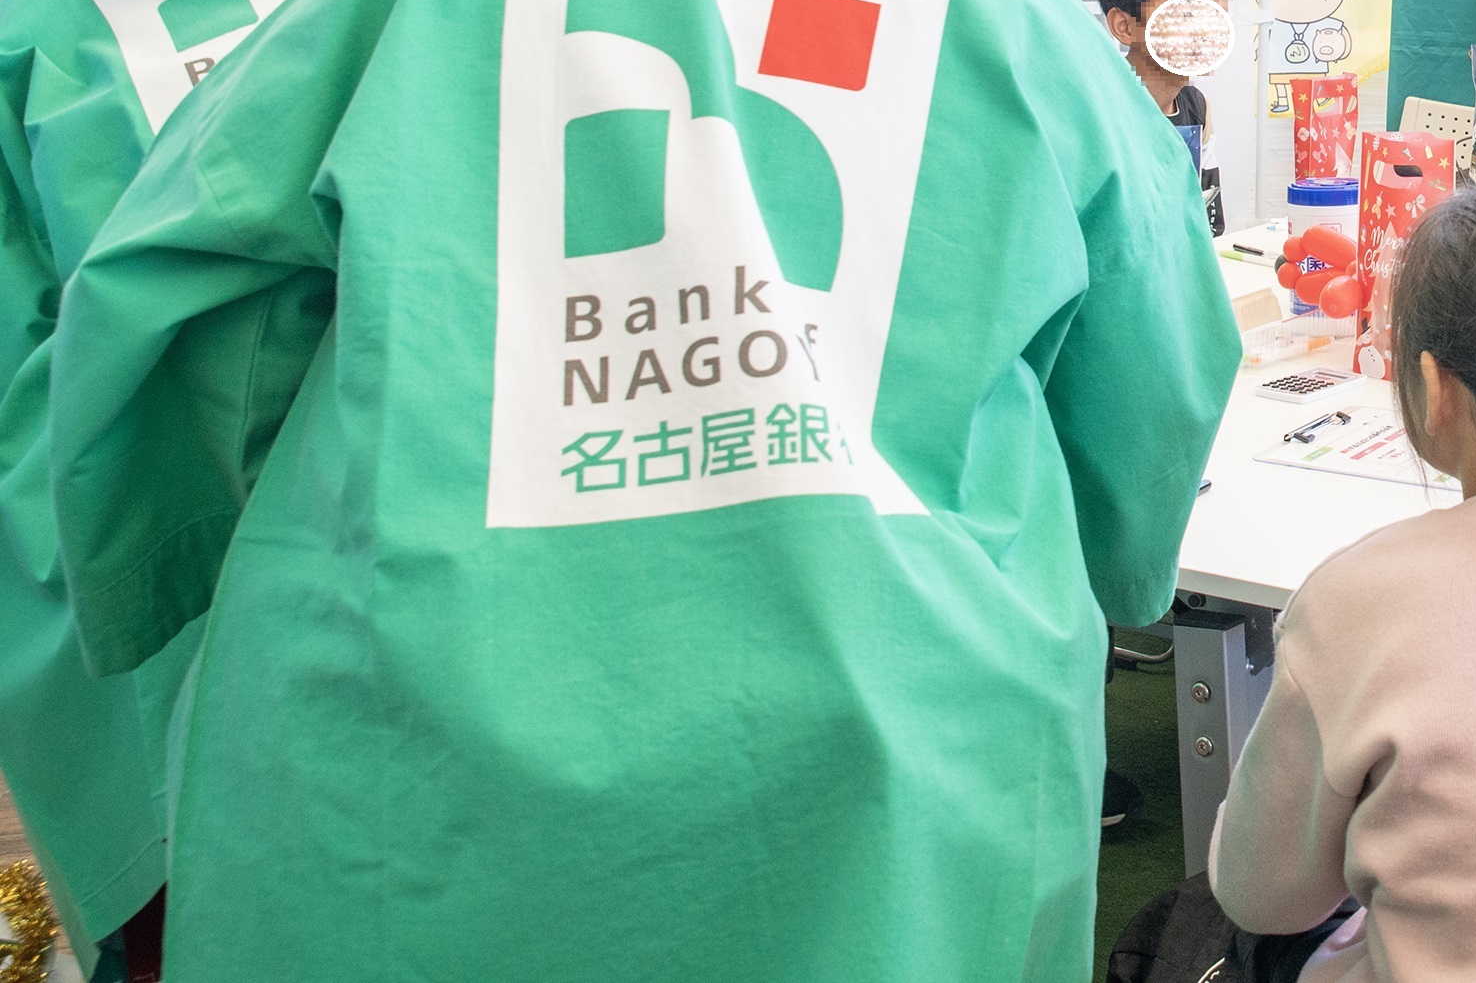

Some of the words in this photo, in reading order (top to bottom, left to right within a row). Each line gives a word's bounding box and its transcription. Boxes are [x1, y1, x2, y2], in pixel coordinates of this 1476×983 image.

[1370, 225, 1411, 250] Merr
[564, 265, 772, 343] Bank
[560, 401, 854, 493] 名古屋銀
